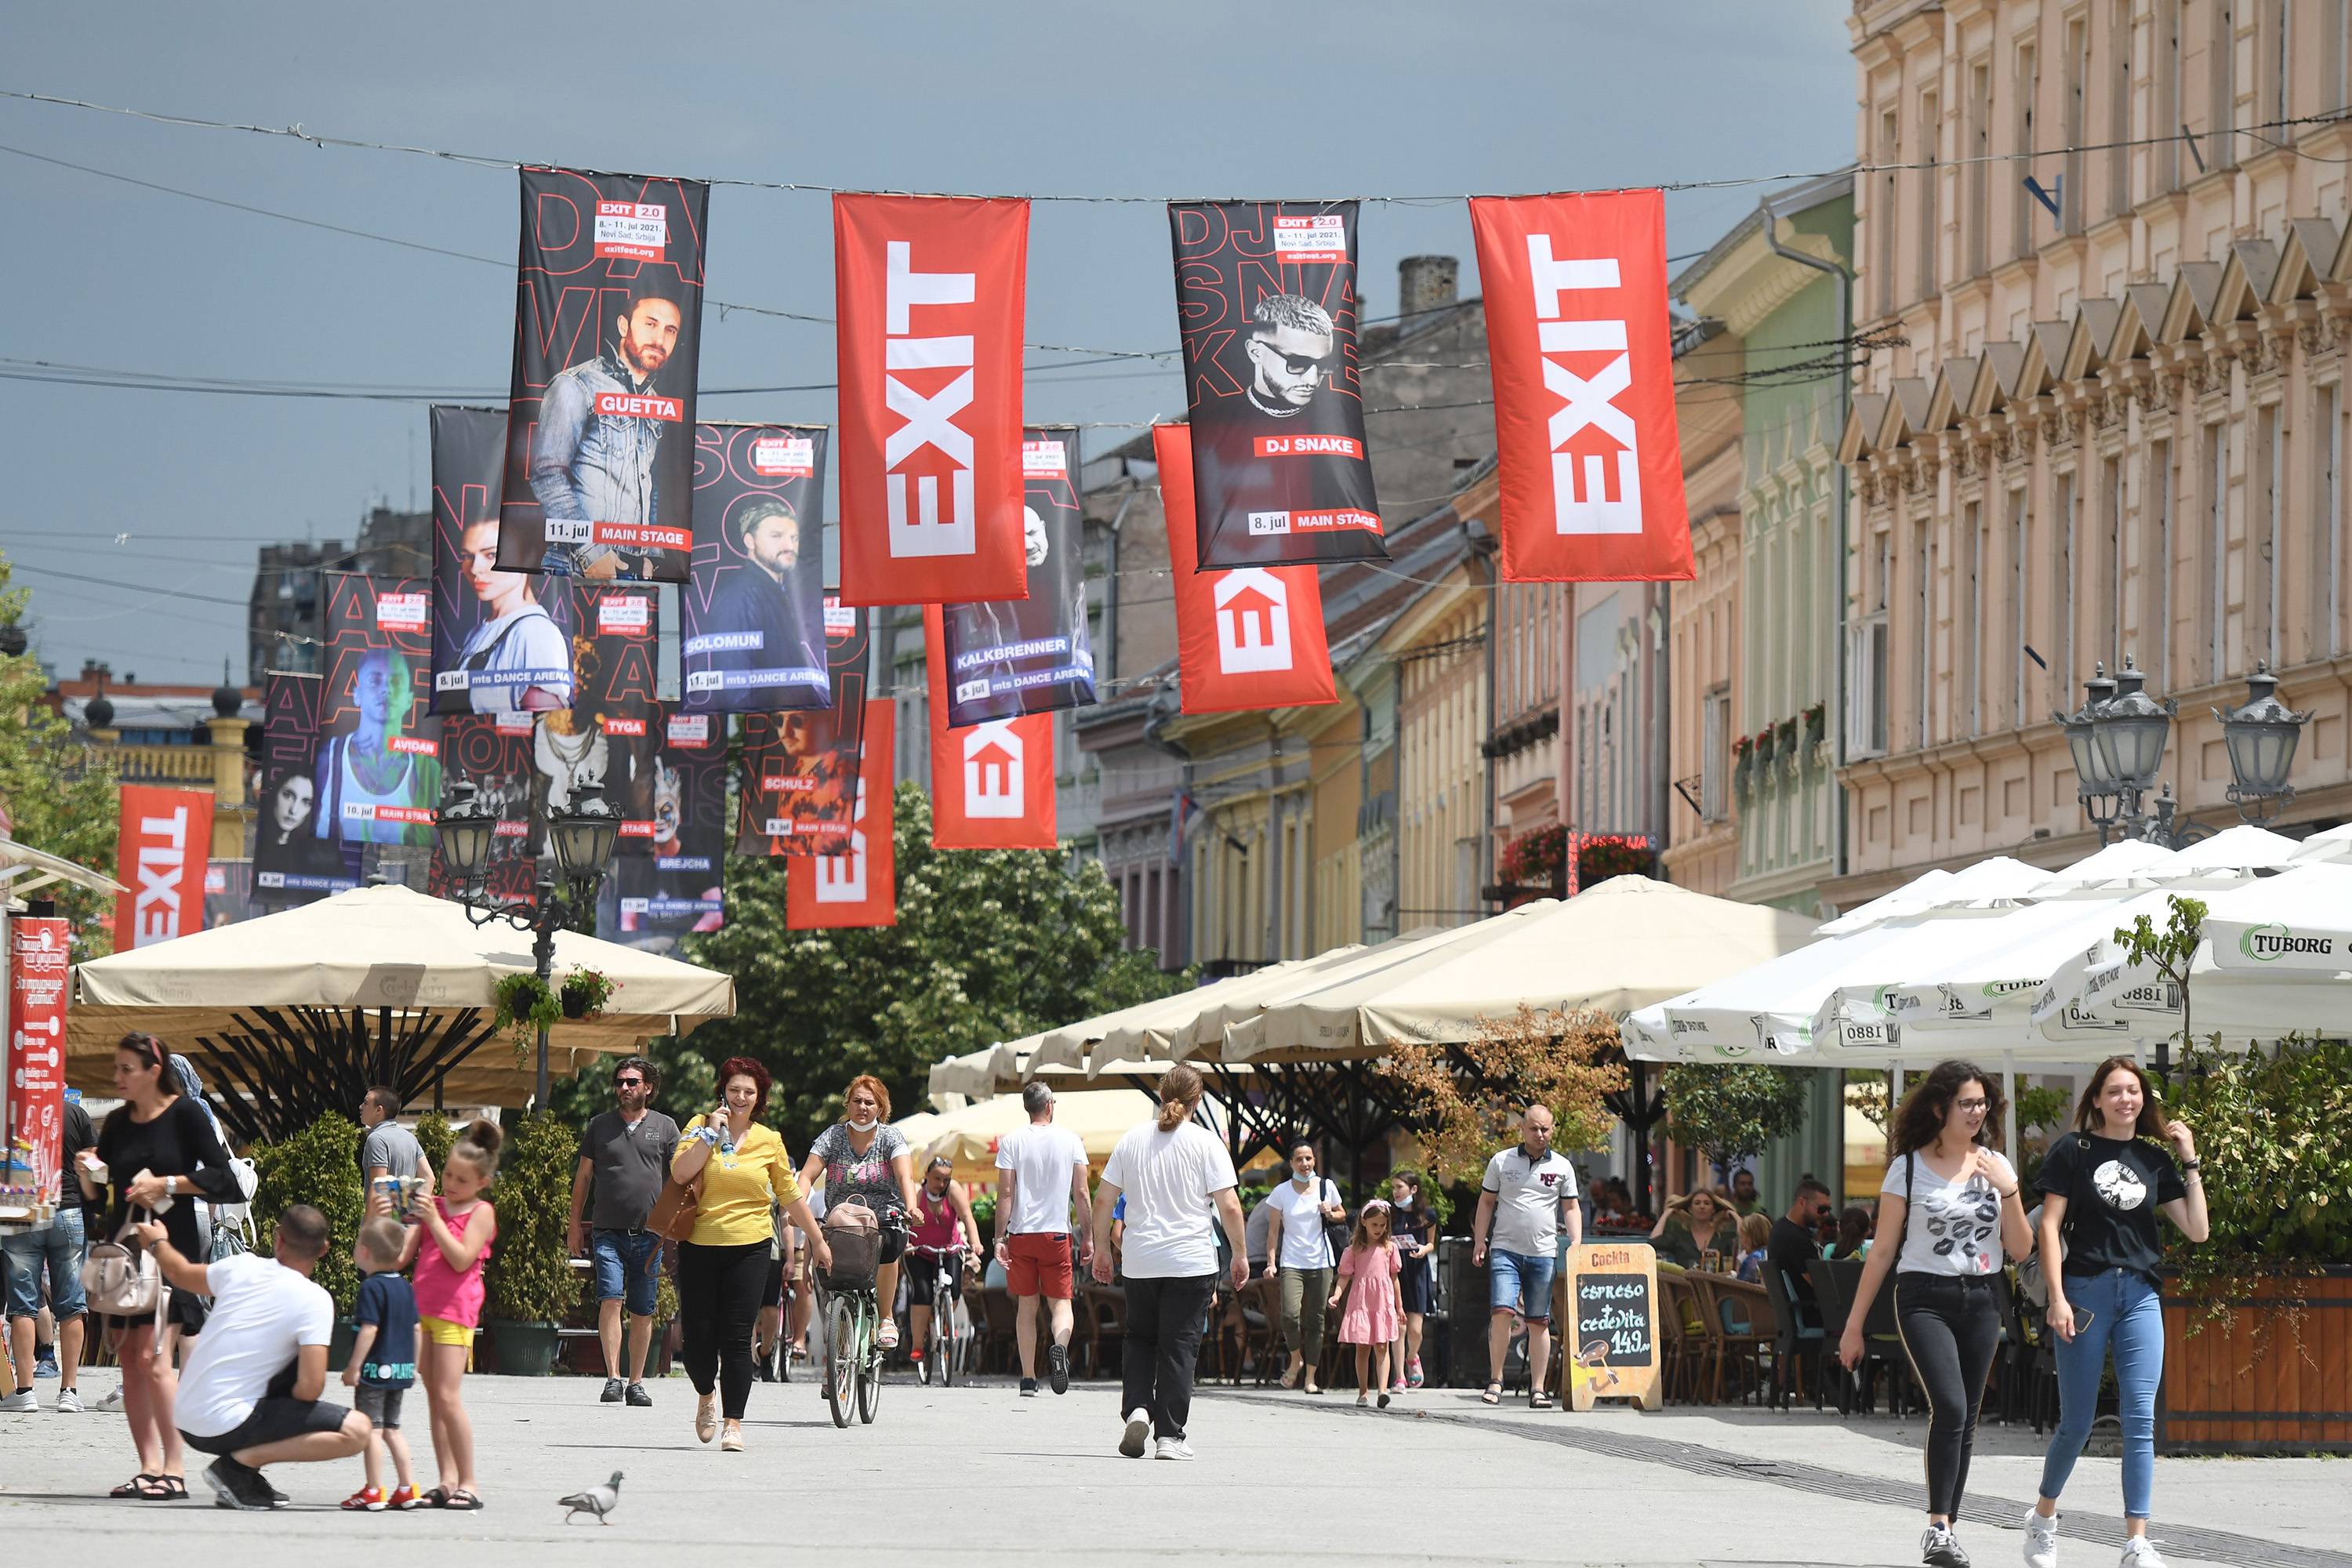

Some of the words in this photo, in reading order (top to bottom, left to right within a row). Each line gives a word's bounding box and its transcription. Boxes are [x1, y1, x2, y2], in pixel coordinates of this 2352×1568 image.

[601, 203, 632, 215] EXIT
[641, 207, 660, 217] 2.0
[628, 223, 638, 231] jul
[640, 223, 662, 233] 2021.
[1278, 218, 1309, 227] EXIT
[601, 230, 616, 238] Novi
[618, 231, 633, 241] Sad,
[635, 233, 656, 243] Srbija
[1307, 231, 1317, 240] jul
[604, 245, 655, 259] exitfest.org
[1526, 233, 1644, 535] EXIT
[601, 395, 677, 417] GUETTA
[885, 241, 976, 558] EXIT
[1265, 439, 1290, 453] DJ
[1293, 437, 1355, 454] SNAKE
[1254, 517, 1268, 529] 8.
[1269, 516, 1287, 531] jul
[1298, 514, 1333, 528] MAIN
[1336, 514, 1378, 528] STAGE
[549, 523, 570, 538] 11.
[572, 523, 590, 540] jul
[601, 526, 637, 542] MAIN
[640, 529, 684, 546] STAGE
[685, 633, 761, 654] SOLOMUN
[956, 637, 1067, 670] KALKBRENNER
[440, 675, 451, 685] 8.
[452, 673, 464, 686] jul
[471, 675, 492, 684] mts
[493, 672, 532, 684] DANCE
[533, 672, 571, 683] ARENA
[688, 676, 705, 690] 11.
[706, 674, 720, 689] jul
[726, 676, 746, 686] mts
[748, 672, 788, 685] DANCE
[789, 670, 827, 685] ARENA
[971, 682, 986, 696] jul
[991, 681, 1013, 692] mts
[1014, 673, 1052, 688] DANCE
[1053, 666, 1091, 683] ARENA
[608, 720, 642, 734] TYGA
[394, 739, 436, 753] AVIDAN
[764, 778, 815, 790] SCHULZ
[346, 805, 360, 817] 10.
[361, 807, 372, 817] jul
[379, 809, 404, 820] MAIN
[405, 811, 430, 822] STAG
[621, 825, 652, 835] STAGE
[795, 824, 819, 834] MAIN
[820, 824, 848, 834] STAGE
[659, 858, 711, 870] BREJCHA
[132, 805, 189, 950] EXIT
[2254, 934, 2332, 955] TUBORG
[2103, 1192, 2118, 1206] ALL
[1591, 1250, 1630, 1268] Cockta
[1580, 1308, 1646, 1333] cedevita
